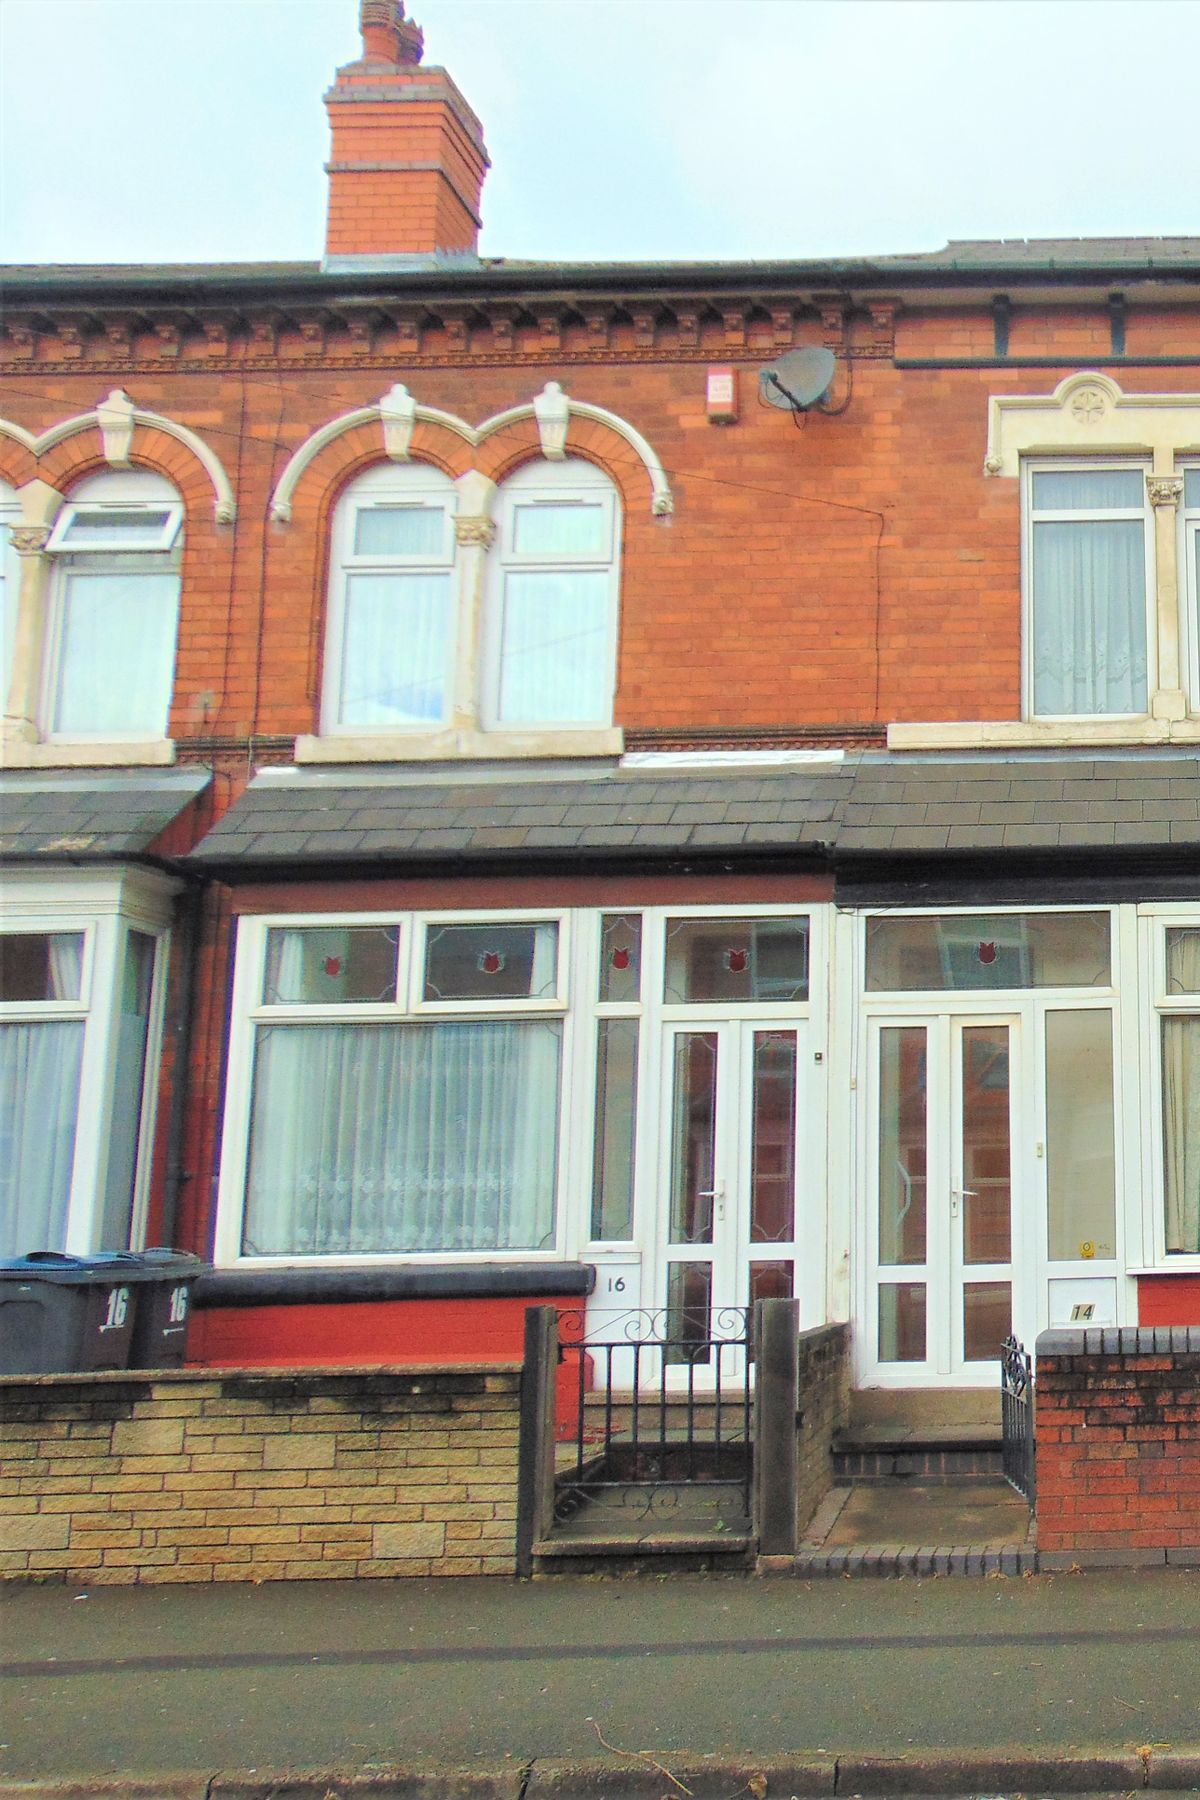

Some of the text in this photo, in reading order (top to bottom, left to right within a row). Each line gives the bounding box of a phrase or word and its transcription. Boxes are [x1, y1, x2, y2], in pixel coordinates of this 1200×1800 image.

[608, 1277, 626, 1293] 16
[107, 1287, 129, 1325] 16
[169, 1286, 188, 1323] 16
[1073, 1304, 1093, 1321] 14
